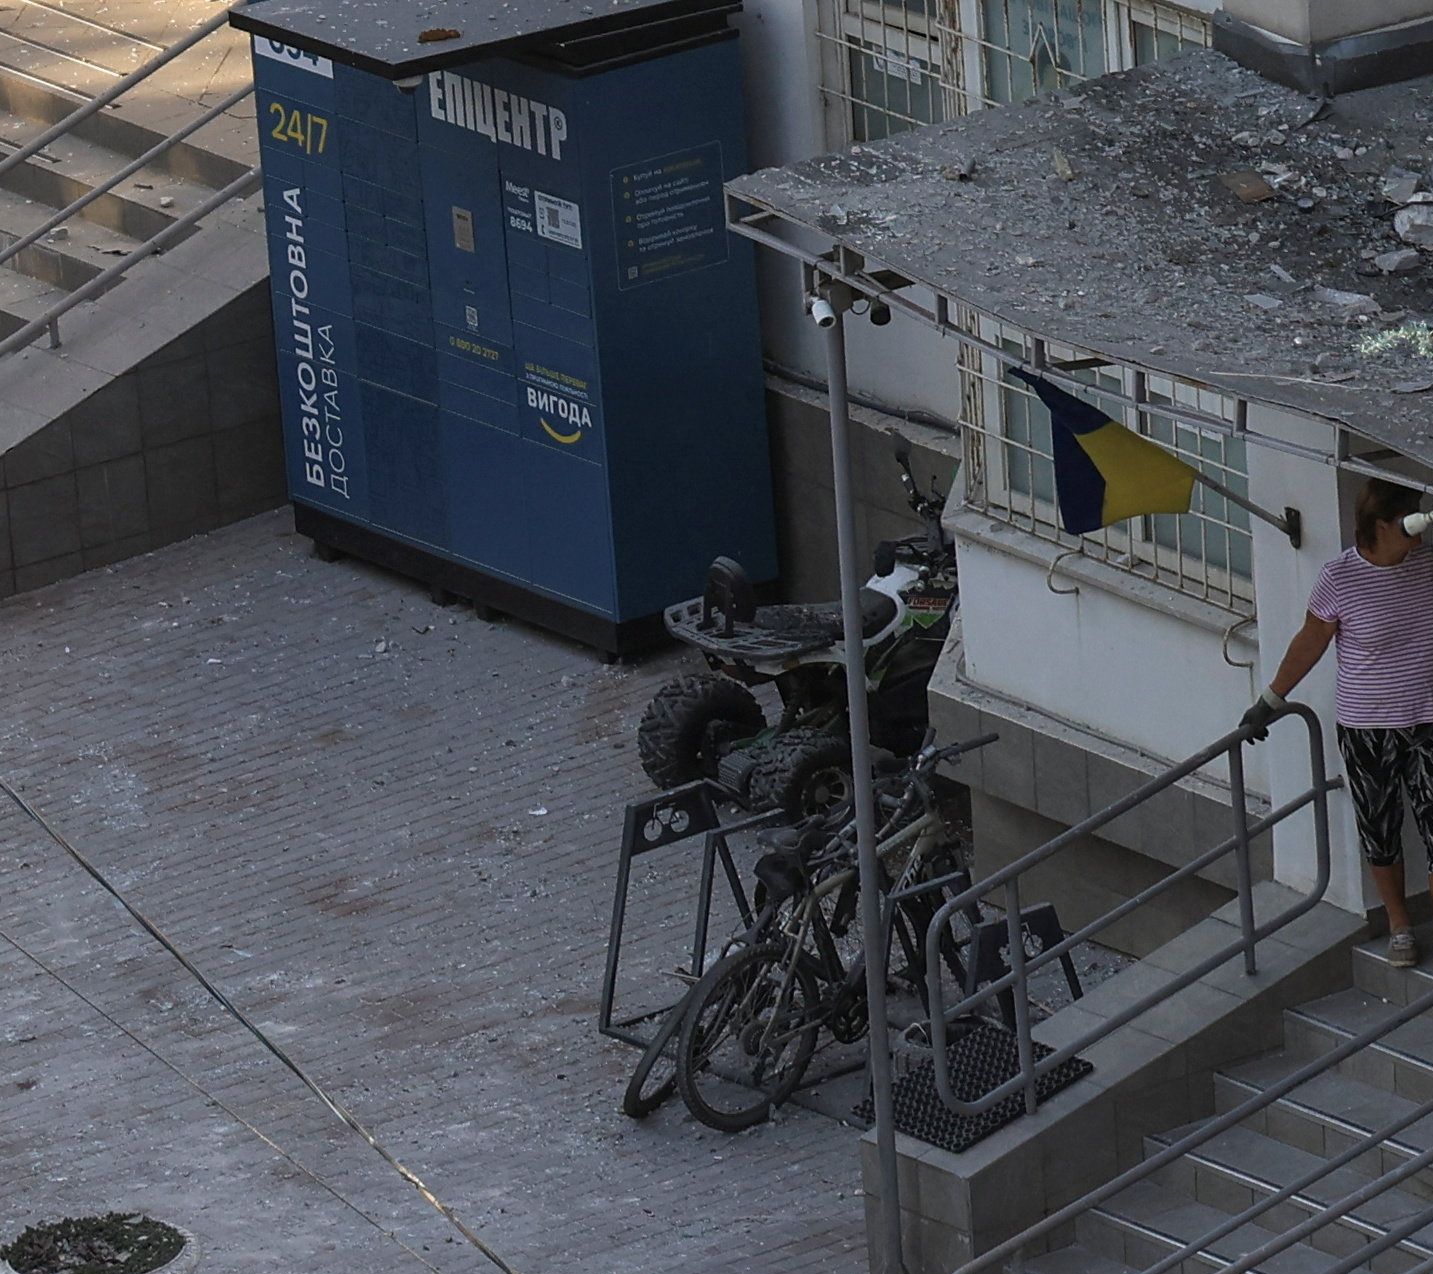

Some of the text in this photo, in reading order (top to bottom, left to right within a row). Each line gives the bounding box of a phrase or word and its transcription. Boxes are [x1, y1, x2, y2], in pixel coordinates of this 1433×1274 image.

[428, 70, 568, 161] ЕПІЦЕНТР
[283, 187, 325, 488] БЕЗКОШТОВНА
[318, 324, 350, 499] ДОСТАВКА
[527, 387, 592, 428] ВИГОДА
